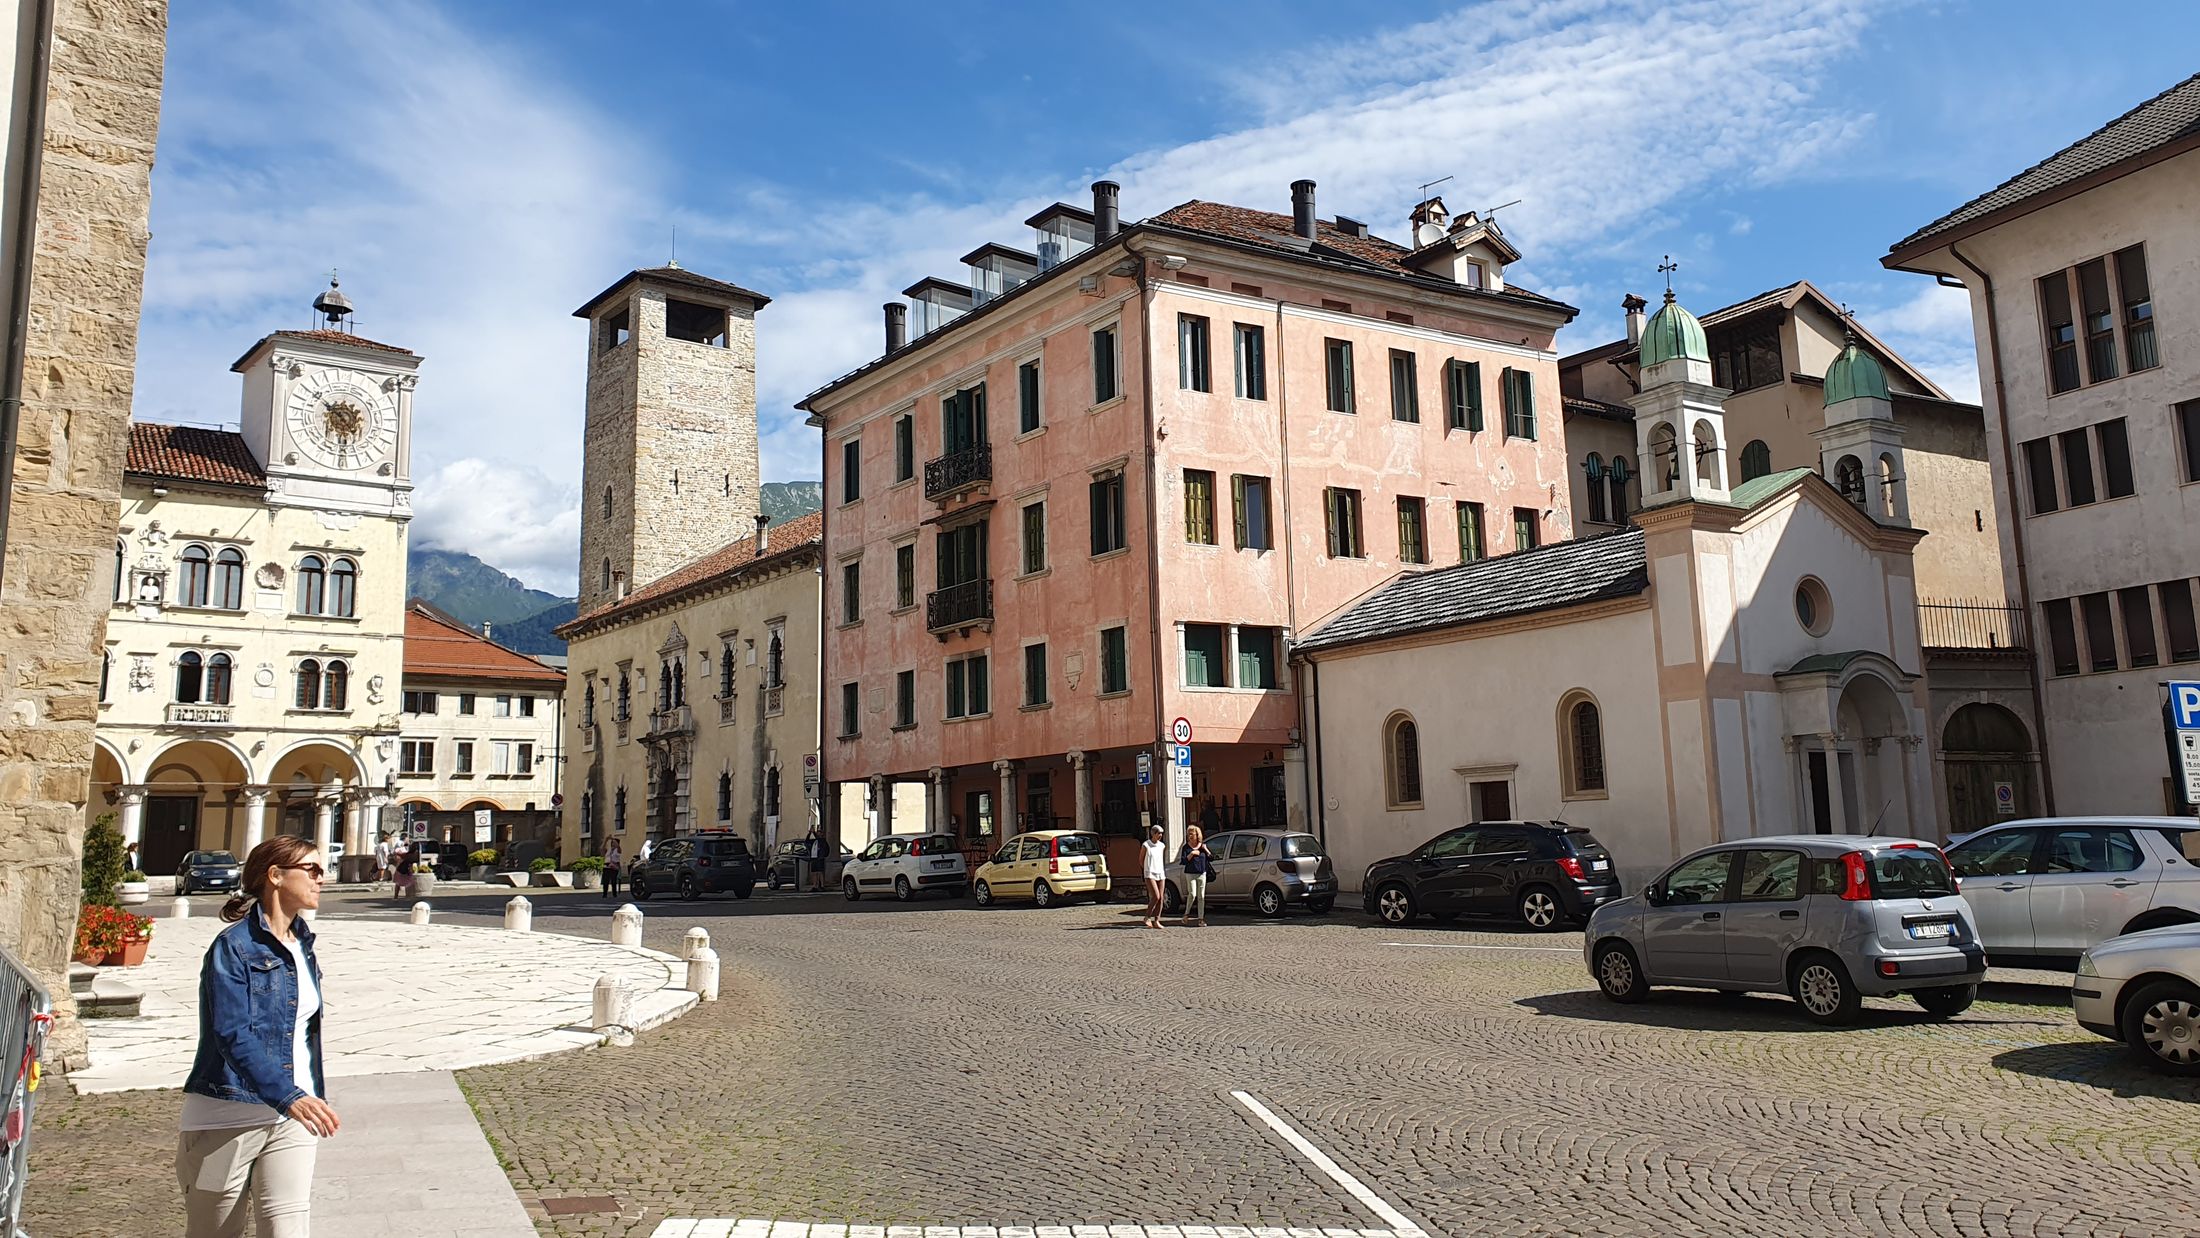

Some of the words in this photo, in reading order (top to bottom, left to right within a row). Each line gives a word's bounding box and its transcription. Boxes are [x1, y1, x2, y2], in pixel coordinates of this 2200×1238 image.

[2178, 687, 2200, 725] P
[1177, 724, 1188, 737] 30
[1178, 748, 1188, 765] P
